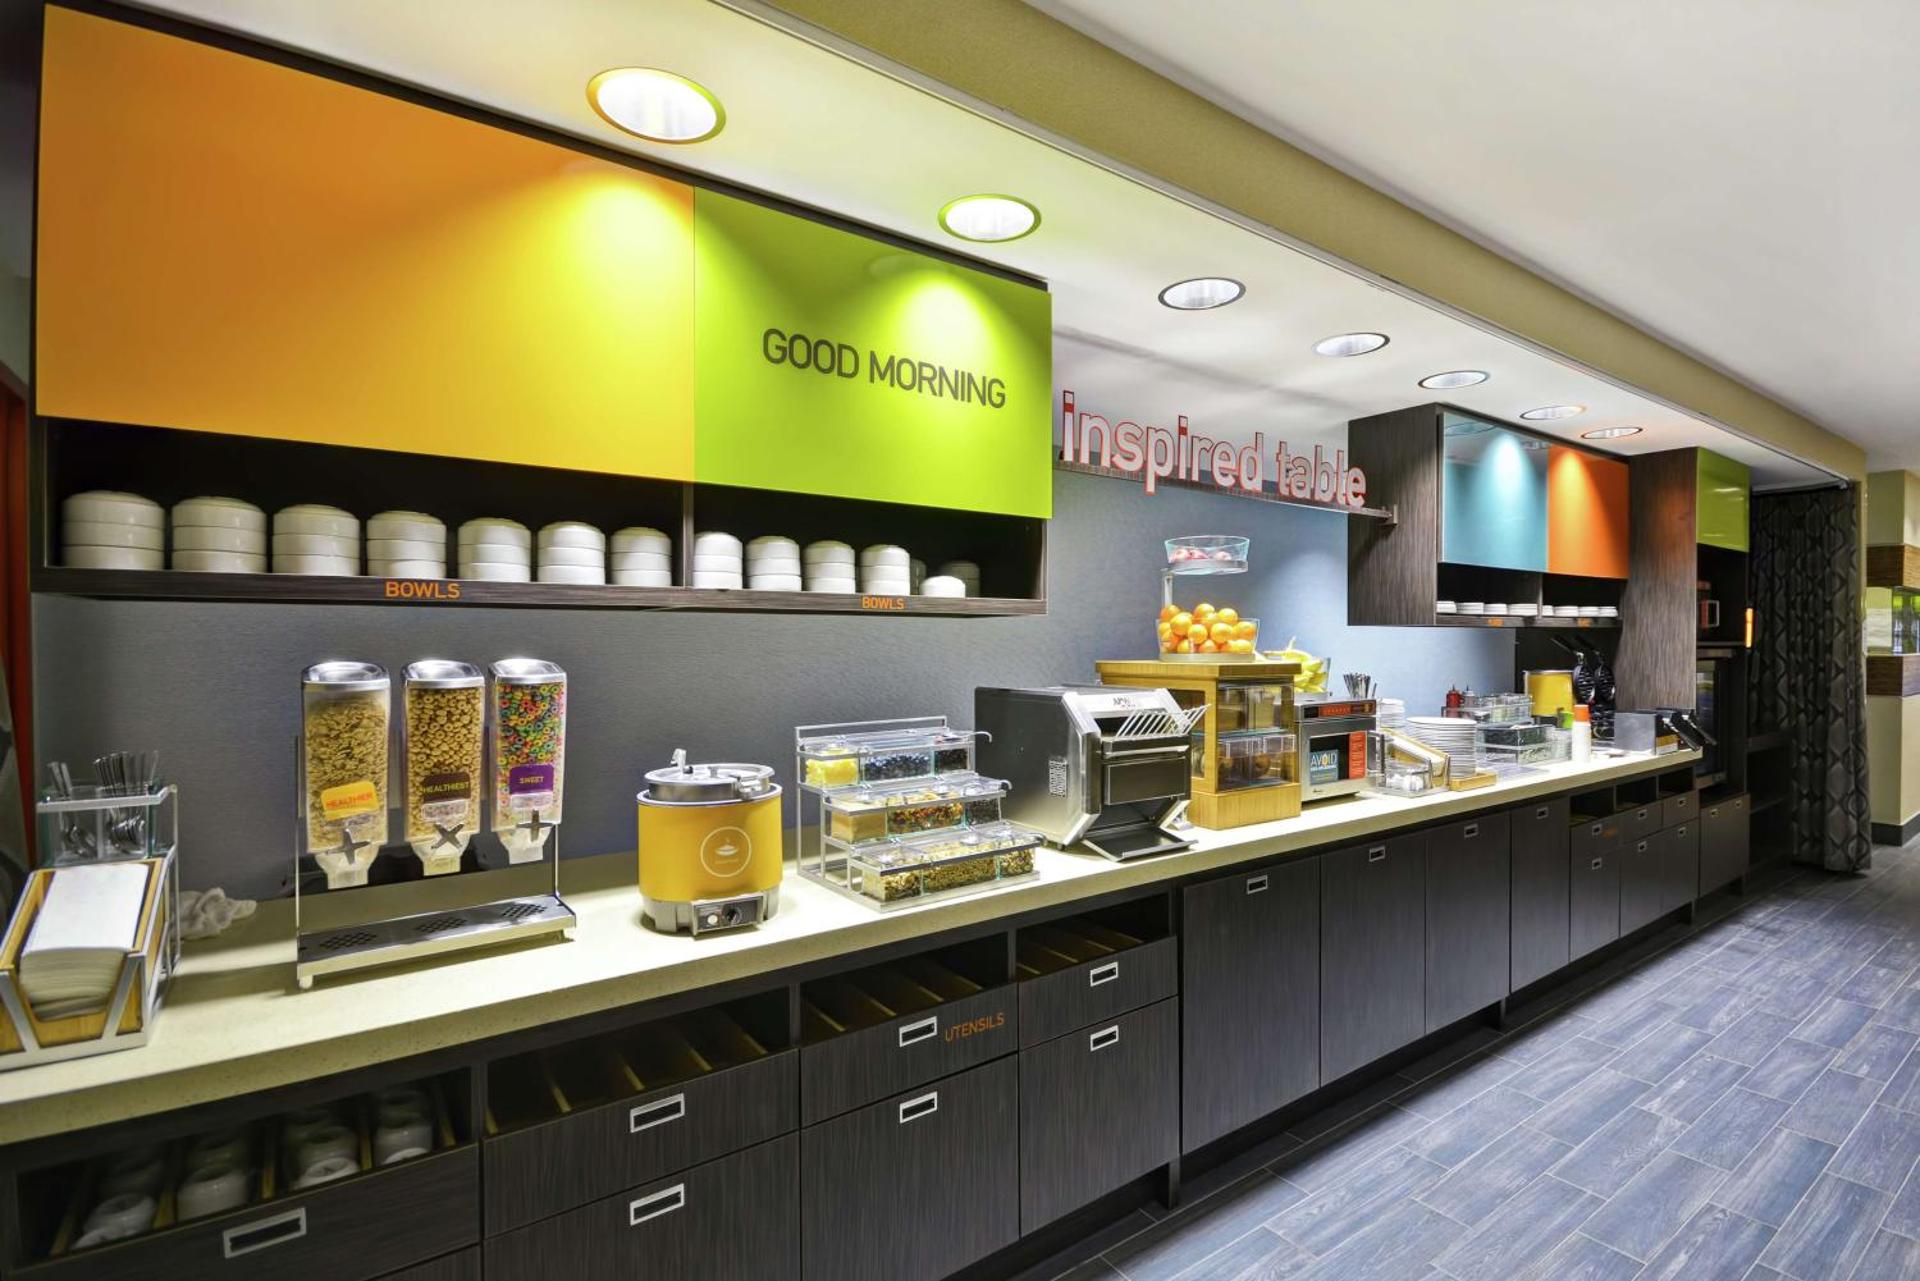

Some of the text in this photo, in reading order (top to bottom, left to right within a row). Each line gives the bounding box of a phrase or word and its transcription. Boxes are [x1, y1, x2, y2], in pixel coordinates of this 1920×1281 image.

[763, 328, 1006, 408] GOOD MORNING
[1062, 389, 1367, 508] inspired table
[385, 580, 461, 599] BOWLS
[861, 596, 905, 610] BOWLS
[422, 781, 469, 794] HEALTHIEST
[519, 775, 544, 784] SWEET
[325, 791, 373, 809] HEALTHIER
[944, 1012, 1005, 1042] UTENSILS
